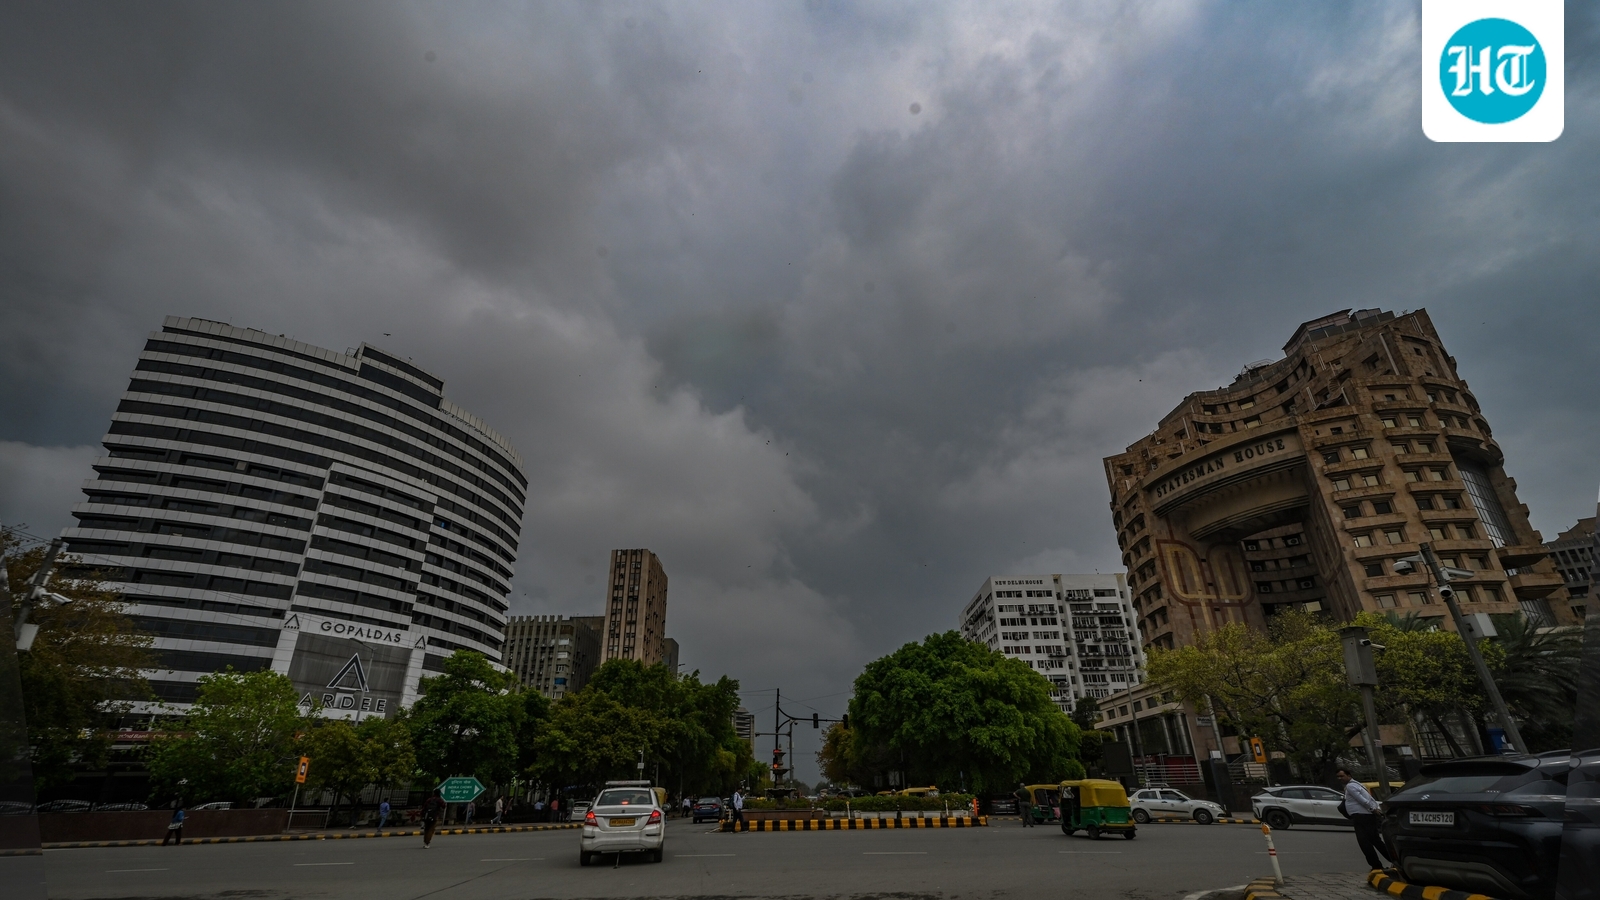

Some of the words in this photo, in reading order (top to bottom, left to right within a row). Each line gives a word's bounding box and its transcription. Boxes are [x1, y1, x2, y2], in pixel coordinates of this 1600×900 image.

[1156, 457, 1225, 498] STATESMAN
[1233, 438, 1285, 464] HOUSE
[320, 621, 401, 643] GOPALDAS
[297, 691, 387, 713] ARDEE
[1412, 813, 1454, 823] DL14CH5120
